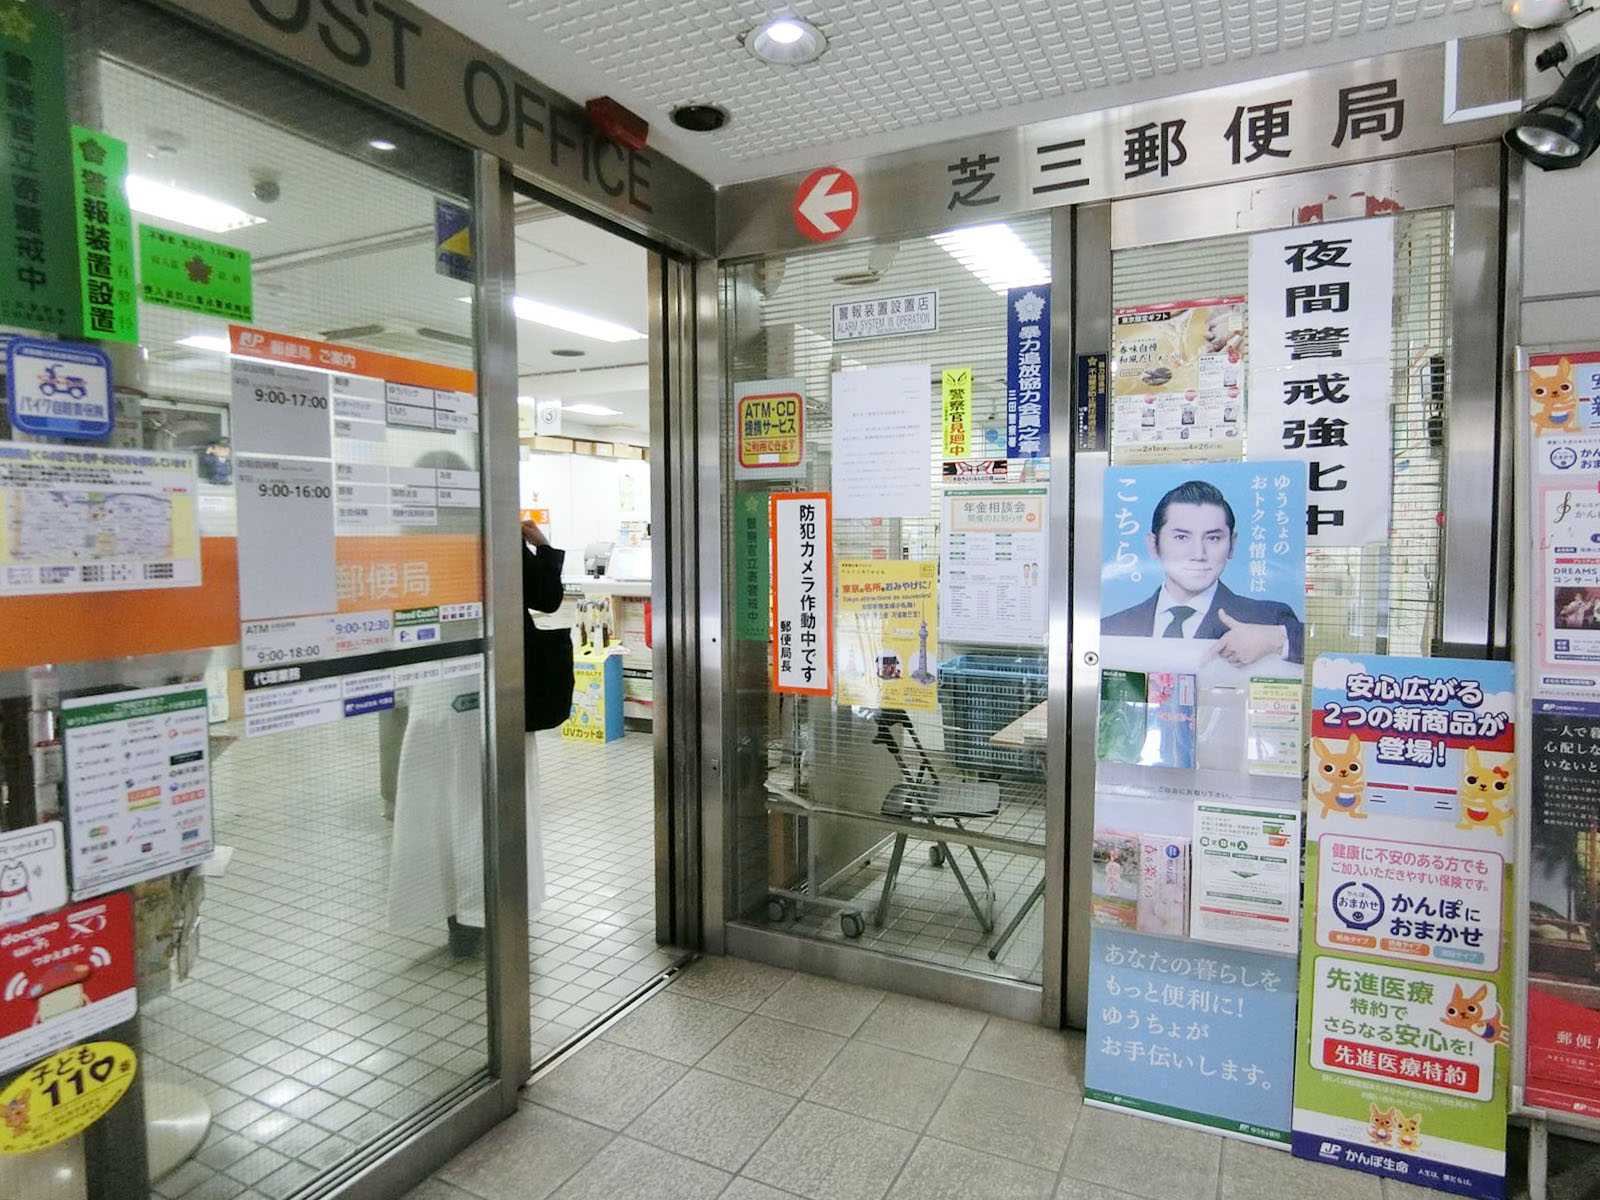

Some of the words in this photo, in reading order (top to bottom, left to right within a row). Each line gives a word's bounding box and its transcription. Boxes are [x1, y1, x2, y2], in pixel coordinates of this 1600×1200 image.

[464, 59, 653, 214] OFFICE
[947, 79, 1405, 212] 芝三郵便局
[837, 320, 858, 334] ALARM
[861, 317, 885, 331] SYSTEM
[896, 312, 930, 328] OPERATION
[838, 296, 929, 320] 警報装置設置店
[255, 388, 328, 410] 9:00-17:00
[745, 418, 796, 436] 提携サービス
[258, 484, 332, 499] 9:00-16:00
[963, 501, 1026, 514] 年金相談会
[1113, 477, 1142, 583] こちら。
[1272, 474, 1291, 556] ゆうちょの
[1248, 474, 1268, 592] おトクな情報は
[1553, 567, 1598, 576] DREAMS
[799, 504, 817, 683] 防犯カメラ作動中です
[245, 623, 270, 635] ATM
[335, 619, 390, 635] 9:00-12:30
[257, 644, 321, 664] 9:00-18:00
[780, 620, 792, 673] 郵便局長
[1347, 673, 1483, 707] 安心広がる
[1323, 702, 1509, 738] 2つの新商品が
[1377, 735, 1447, 767] 登場!
[1332, 842, 1489, 875] 健康に不安のある方でも
[1331, 862, 1489, 892] ご加入いただきやすい保険です。
[1338, 897, 1379, 911] おまかせ
[1391, 893, 1482, 922] かんぽに
[1390, 917, 1484, 947] おまかせ
[1104, 943, 1282, 992] あなたの暮らしを
[1106, 975, 1244, 1018] もっと便利に!
[1326, 967, 1435, 1005] 先進医療
[1102, 1007, 1211, 1041] ゆうちょが
[1350, 997, 1409, 1021] 特約で
[1324, 1017, 1474, 1057] さらなる安心を!
[31, 1047, 96, 1085] 子ども
[1101, 1036, 1272, 1091] お手伝いします。
[1334, 1044, 1468, 1086] 先進医療特約
[1345, 1148, 1409, 1174] かんぽ生命
